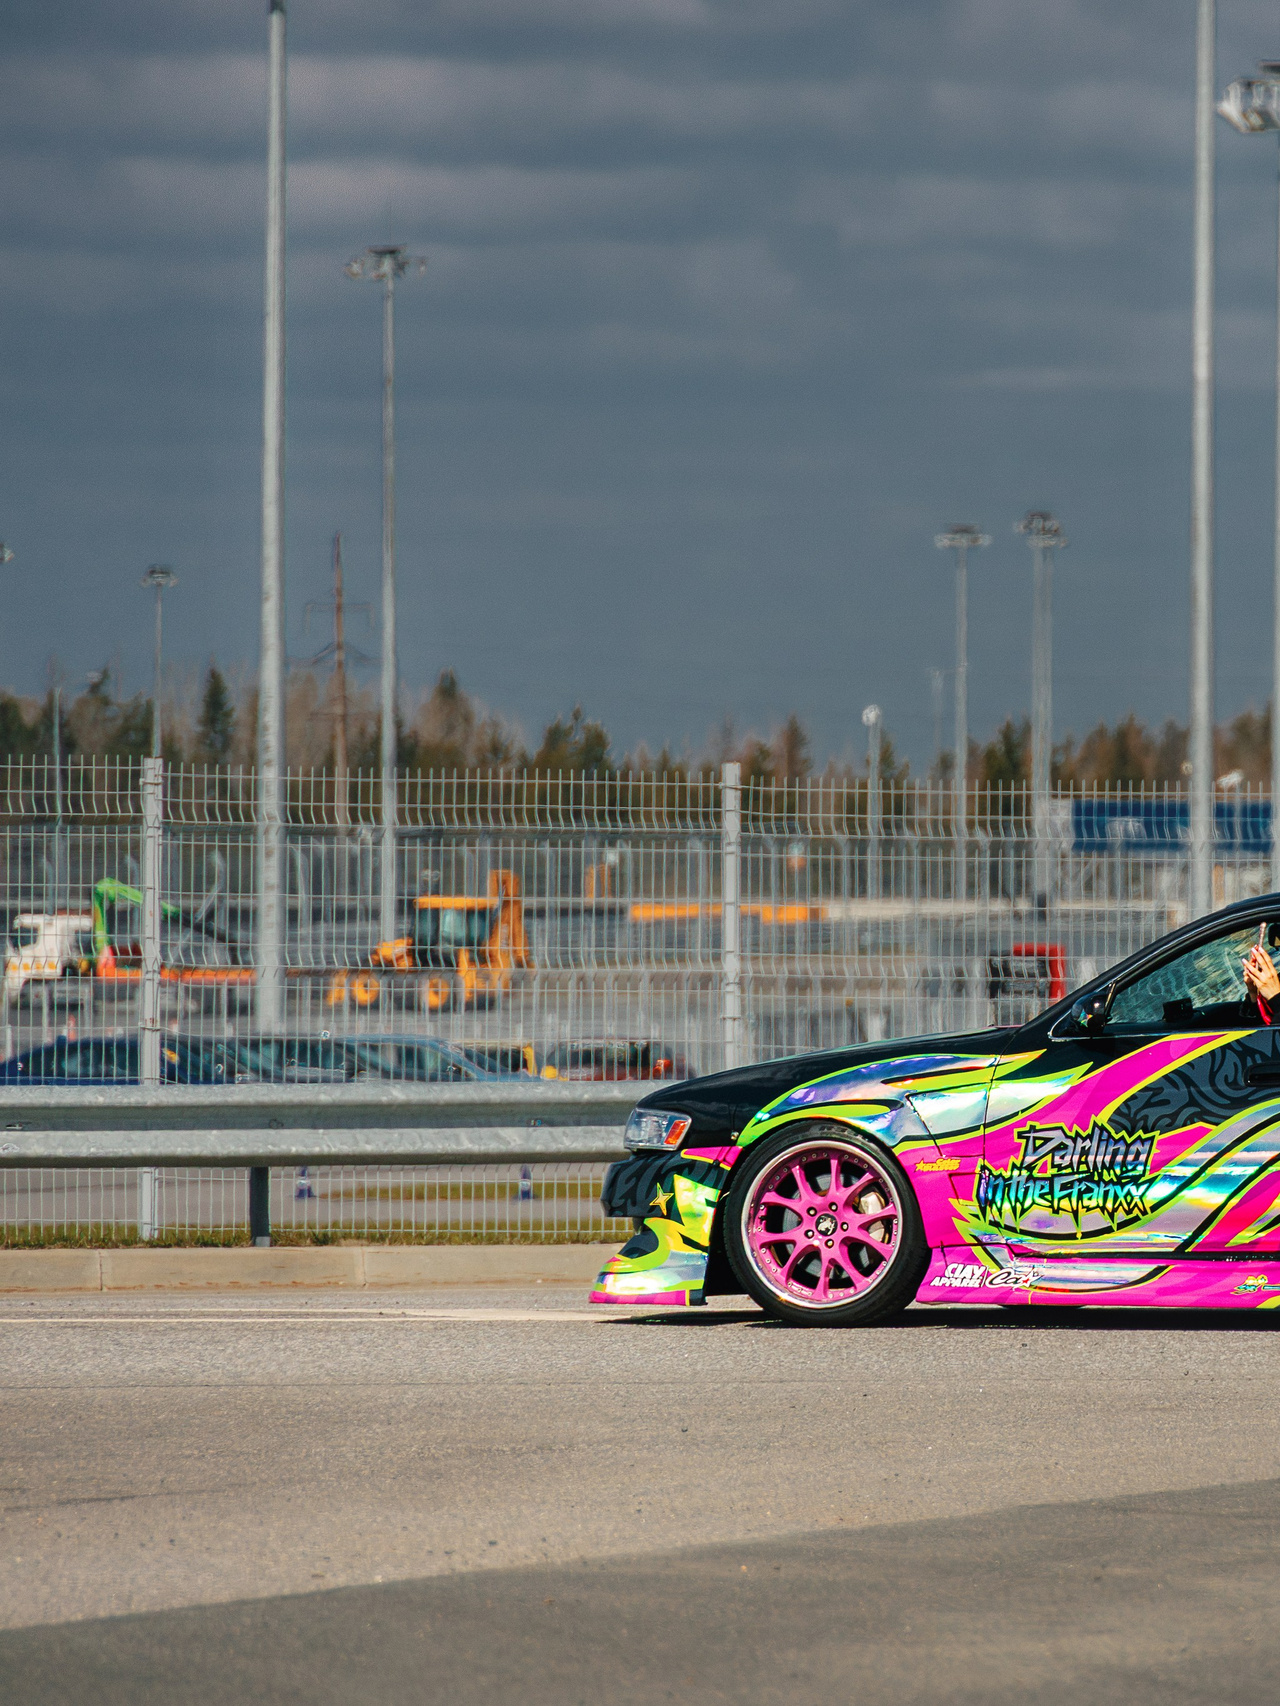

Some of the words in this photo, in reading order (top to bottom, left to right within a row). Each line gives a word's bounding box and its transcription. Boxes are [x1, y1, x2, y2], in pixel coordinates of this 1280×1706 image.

[1020, 1125, 1153, 1178] Darling
[1053, 1174, 1151, 1214] Franxx
[930, 1276, 982, 1288] APPAREL
[944, 1263, 986, 1279] CLAY
